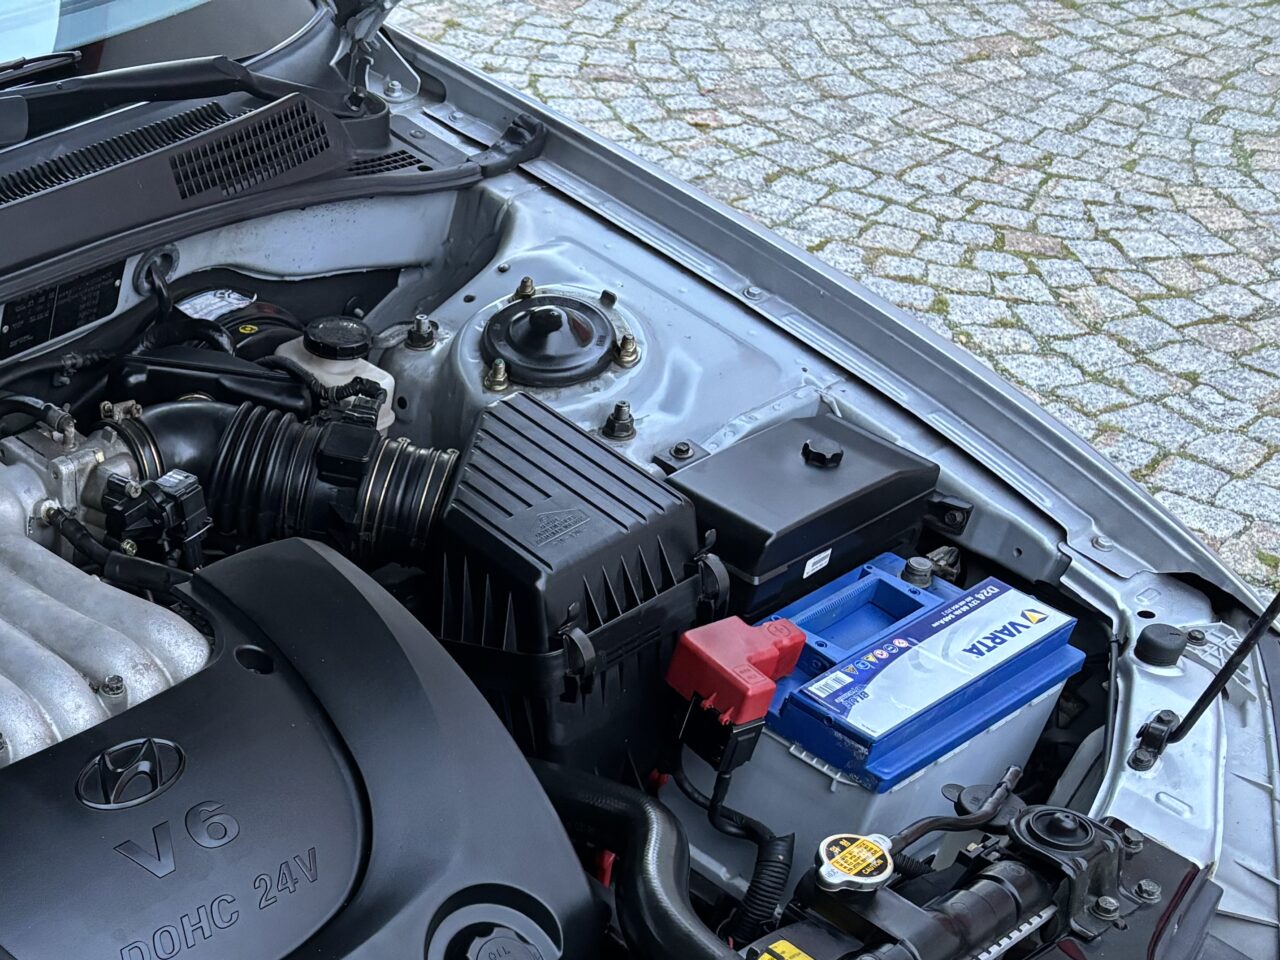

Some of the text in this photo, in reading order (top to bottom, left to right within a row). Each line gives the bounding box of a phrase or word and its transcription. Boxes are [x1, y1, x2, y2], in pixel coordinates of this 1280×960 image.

[974, 584, 999, 600] D24
[962, 621, 1031, 659] VARTA
[841, 690, 869, 709] BLUE
[113, 800, 240, 879] V6
[253, 846, 318, 910] 24V
